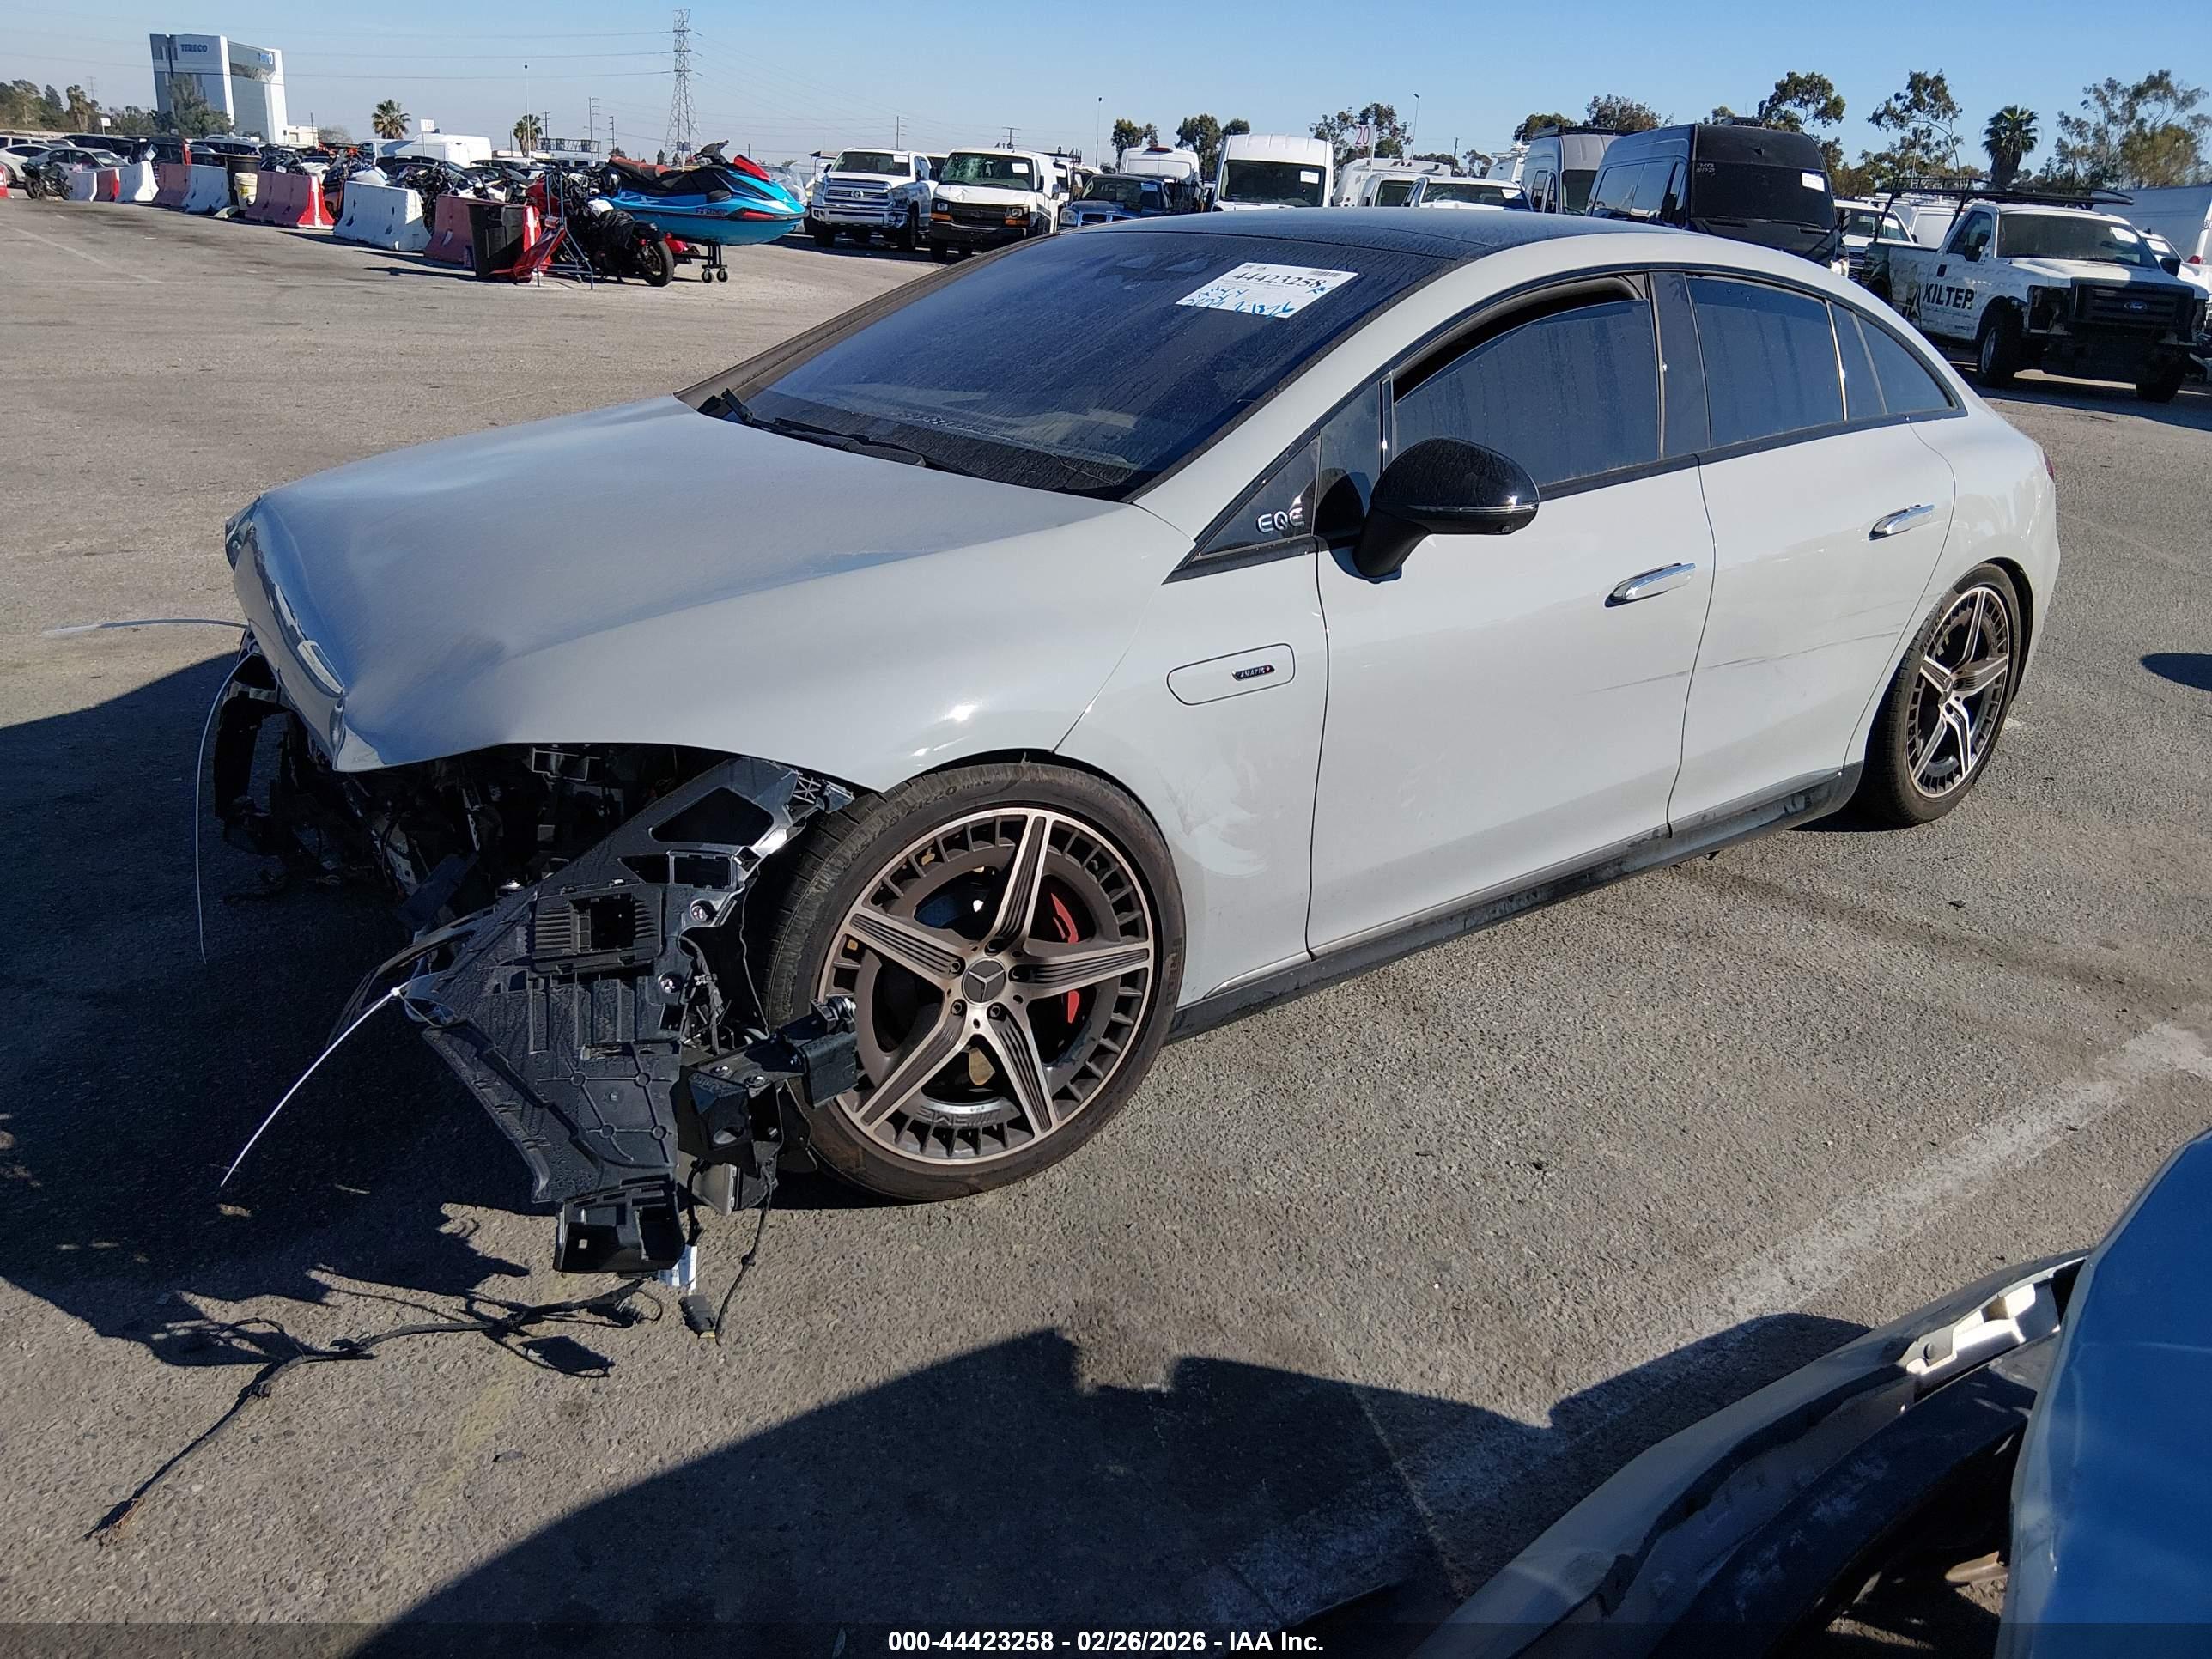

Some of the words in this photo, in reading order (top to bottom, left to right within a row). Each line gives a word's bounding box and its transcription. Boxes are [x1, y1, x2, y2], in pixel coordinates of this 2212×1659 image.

[1355, 125, 1370, 145] 20
[1233, 272, 1328, 288] 44423258
[1257, 507, 1304, 532] EQE
